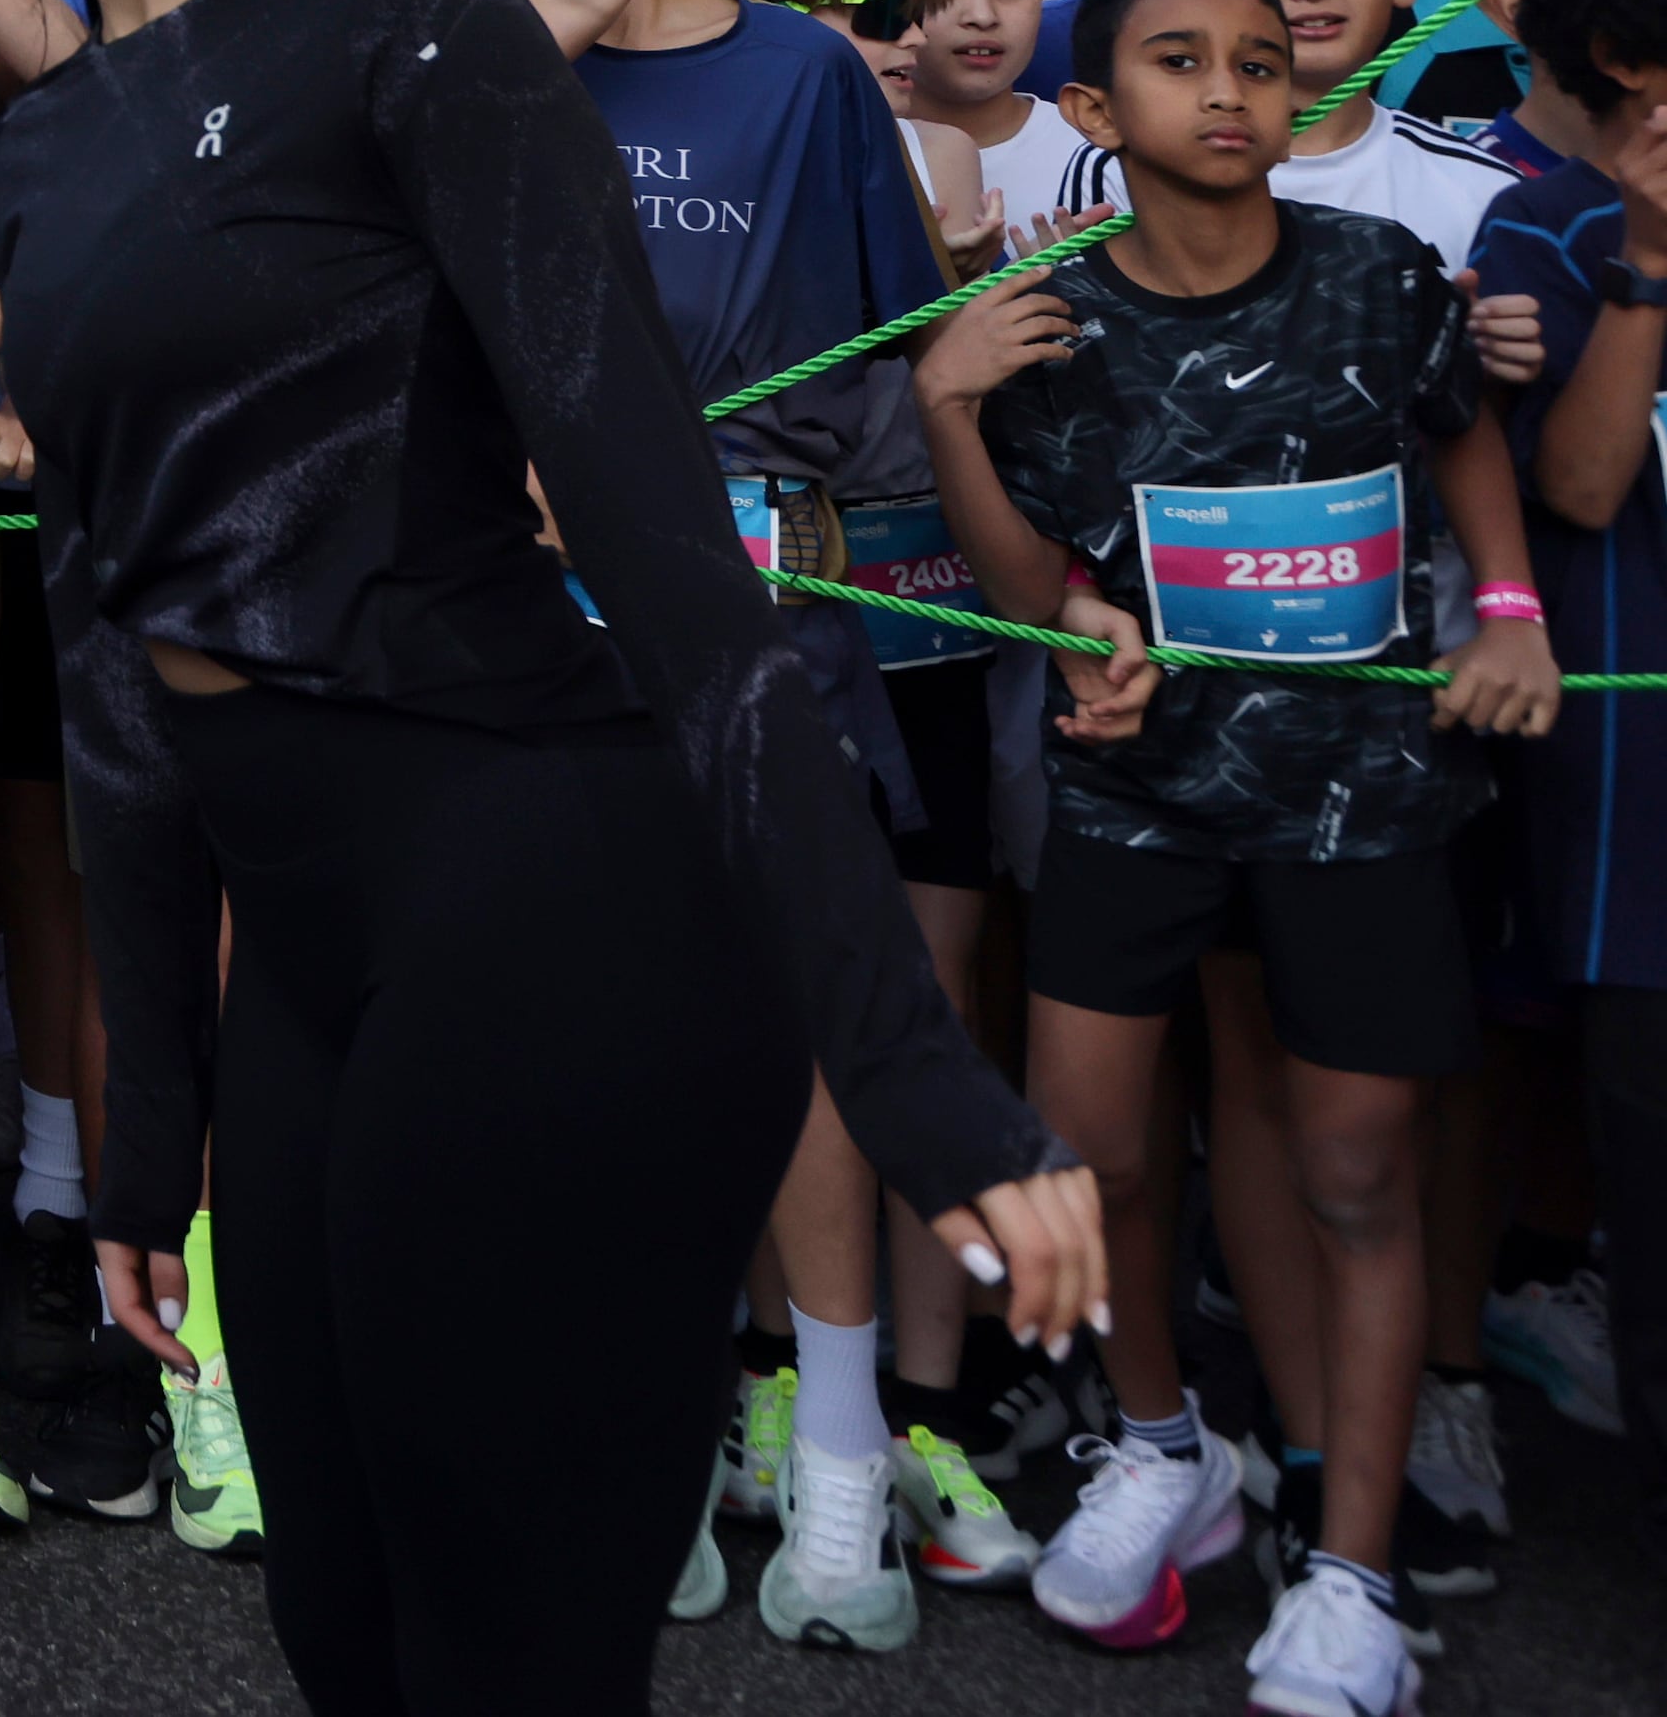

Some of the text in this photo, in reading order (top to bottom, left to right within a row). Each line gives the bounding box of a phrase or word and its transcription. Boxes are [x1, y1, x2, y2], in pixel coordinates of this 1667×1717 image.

[632, 194, 756, 234] TON
[1162, 506, 1229, 524] capelli
[1223, 546, 1360, 587] 2228
